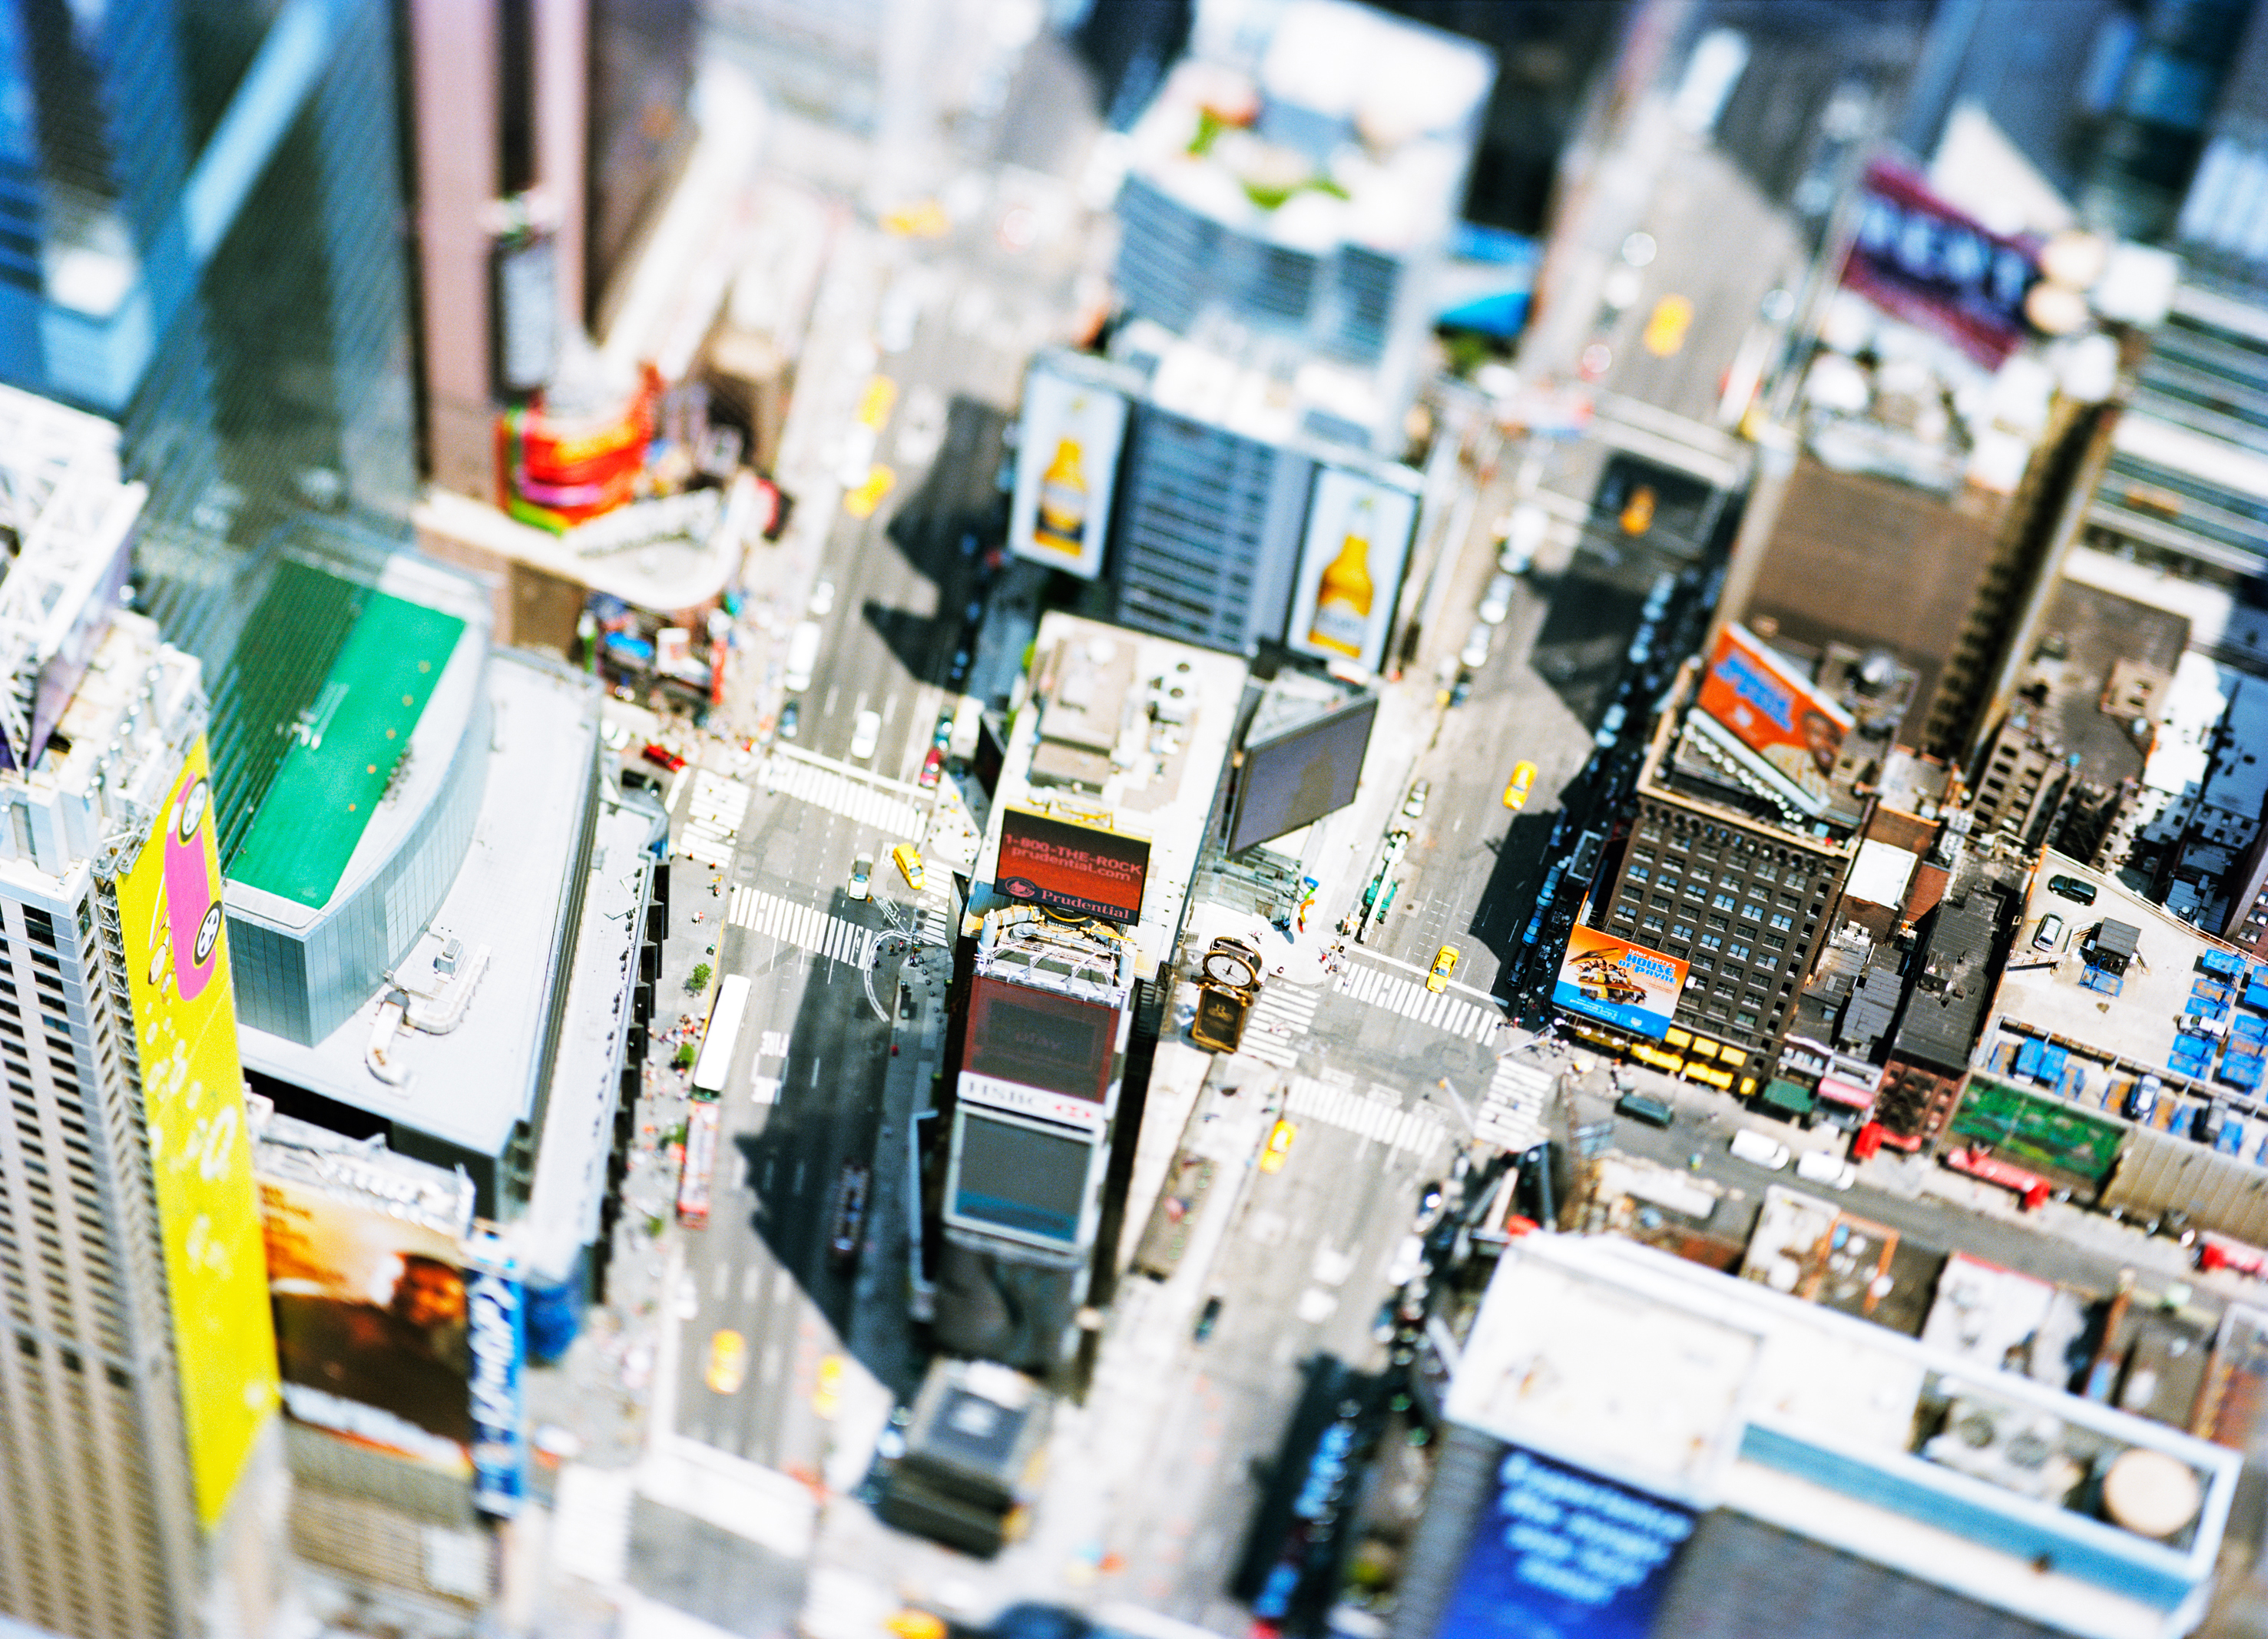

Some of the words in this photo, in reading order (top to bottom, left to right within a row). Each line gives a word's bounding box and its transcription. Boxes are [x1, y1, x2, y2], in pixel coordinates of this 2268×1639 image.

[1004, 833, 1143, 875] 1-800-THE-ROCK
[1011, 846, 1131, 881] prudential.com
[1041, 889, 1130, 919] Prudential
[1625, 953, 1676, 976] HOUSE
[1628, 948, 1647, 958] tyler
